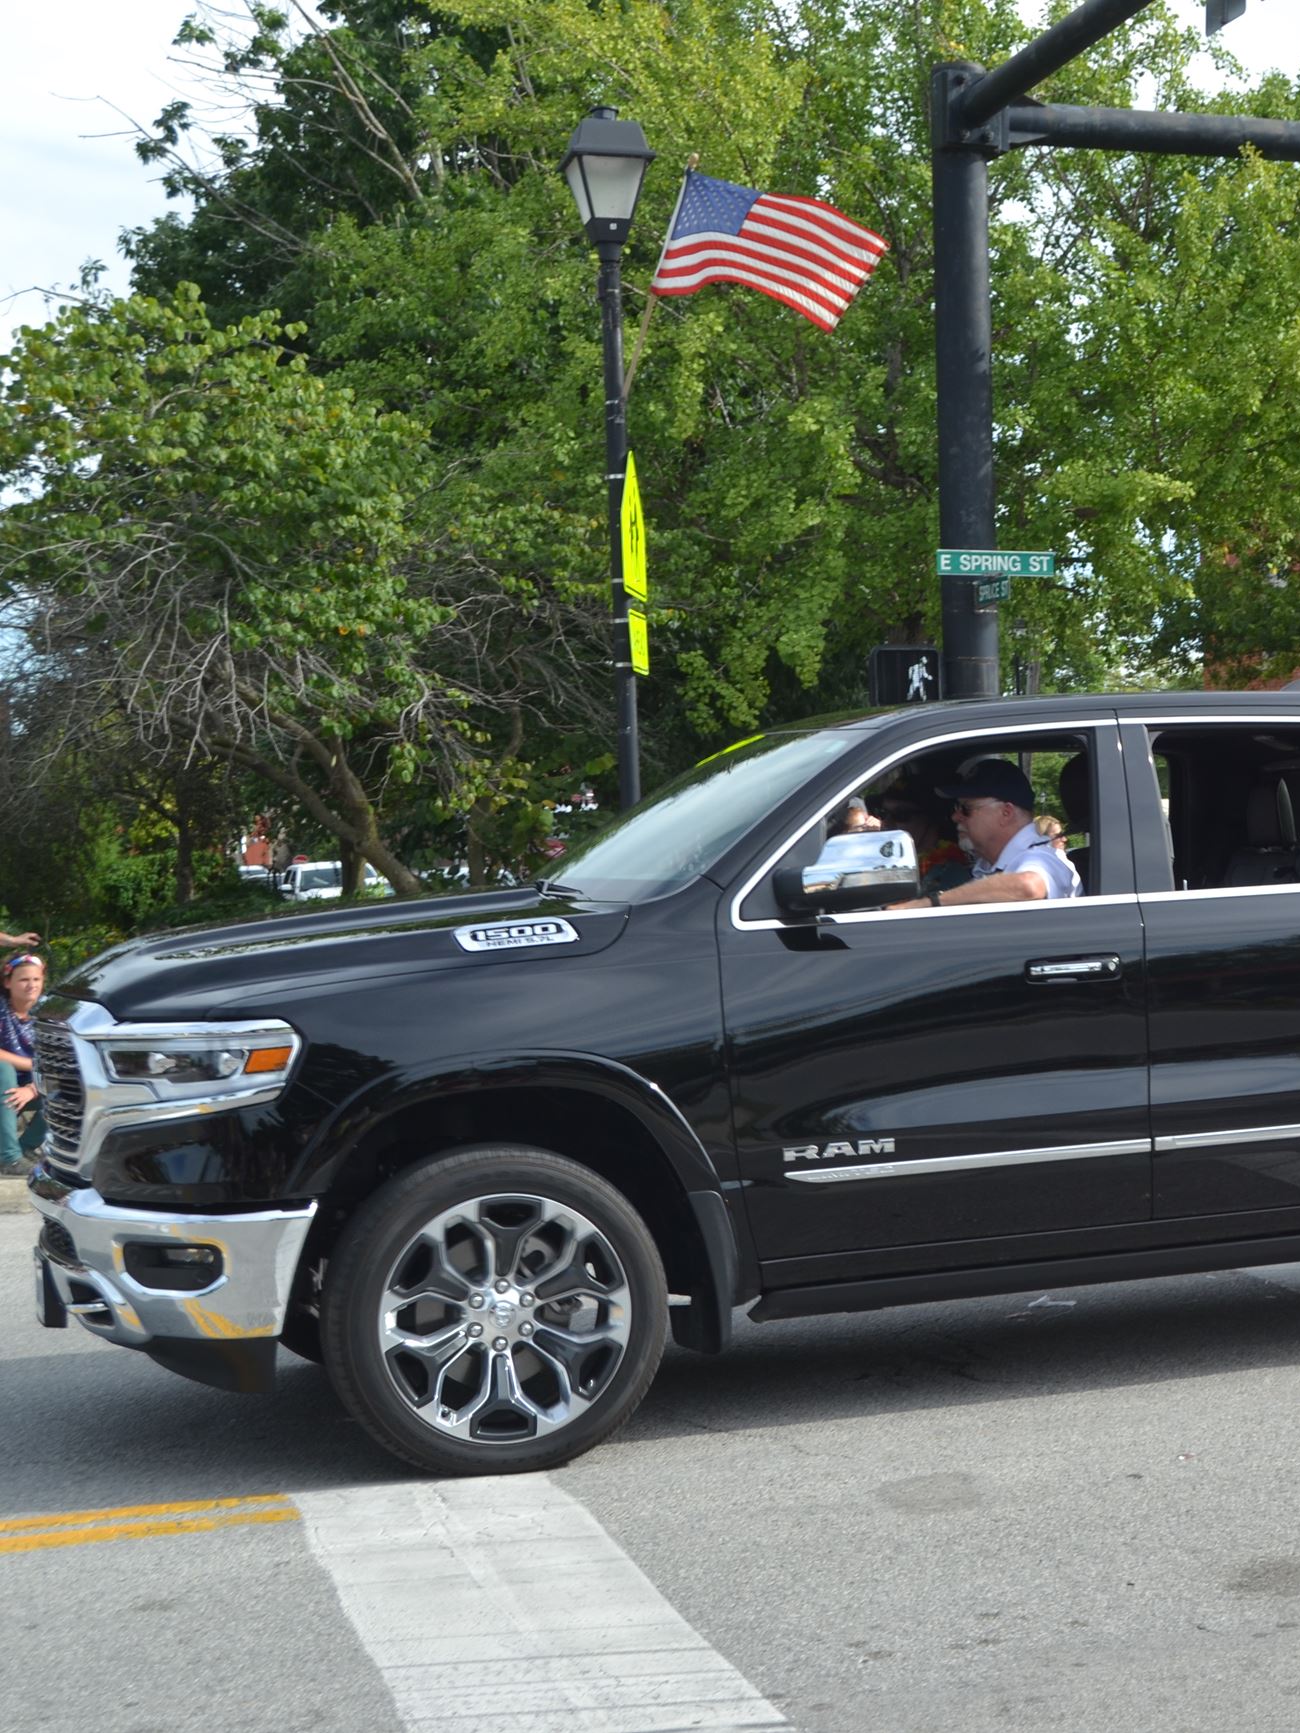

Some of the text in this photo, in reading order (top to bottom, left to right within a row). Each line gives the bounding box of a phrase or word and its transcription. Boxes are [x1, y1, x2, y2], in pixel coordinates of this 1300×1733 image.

[941, 554, 1050, 572] E SPRING ST
[474, 923, 557, 941] 1500
[486, 938, 522, 947] HEMI
[783, 1138, 895, 1161] RAM
